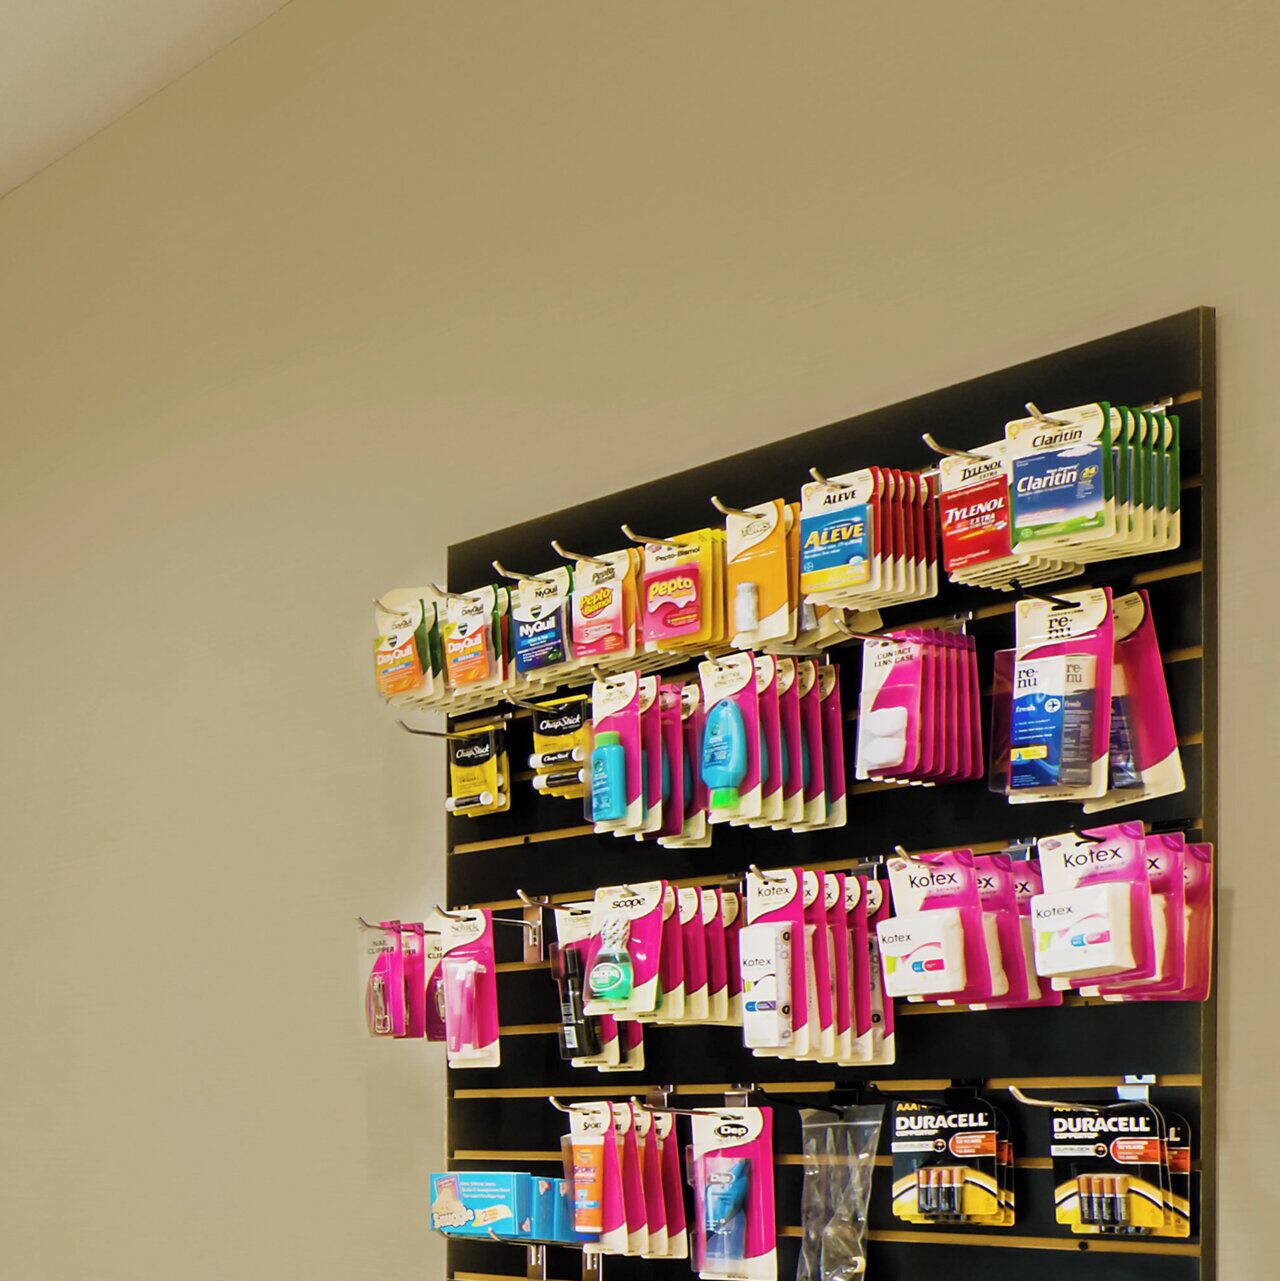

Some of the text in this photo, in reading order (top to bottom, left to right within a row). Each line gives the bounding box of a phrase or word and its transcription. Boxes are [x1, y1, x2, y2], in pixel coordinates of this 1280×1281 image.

[1031, 429, 1084, 448] Claritin
[960, 459, 1004, 481] TYLENOL
[1016, 469, 1079, 494] Claritin
[823, 489, 857, 506] ALEVE
[944, 497, 1006, 526] TYLENOL
[803, 522, 865, 549] ALEVE
[534, 586, 559, 600] NyQuil
[648, 576, 694, 602] Pepto
[519, 616, 556, 638] NyQuil
[447, 634, 483, 654] DayQuil
[376, 644, 413, 667] DayQuil
[874, 653, 915, 668] LENS CASE
[876, 646, 912, 660] CONTACT
[1017, 677, 1038, 689] nu
[539, 713, 581, 731] ChapStick
[455, 744, 490, 760] ChapStick
[1062, 844, 1123, 869] kotex
[908, 871, 959, 890] kotex
[756, 884, 791, 898] kotex
[612, 896, 646, 910] scope
[1035, 903, 1075, 919] kotex
[881, 932, 913, 944] kotex
[742, 957, 773, 968] kotex
[719, 1123, 748, 1137] Dep
[895, 1112, 990, 1131] DURACELL
[1053, 1116, 1151, 1133] DURACELL
